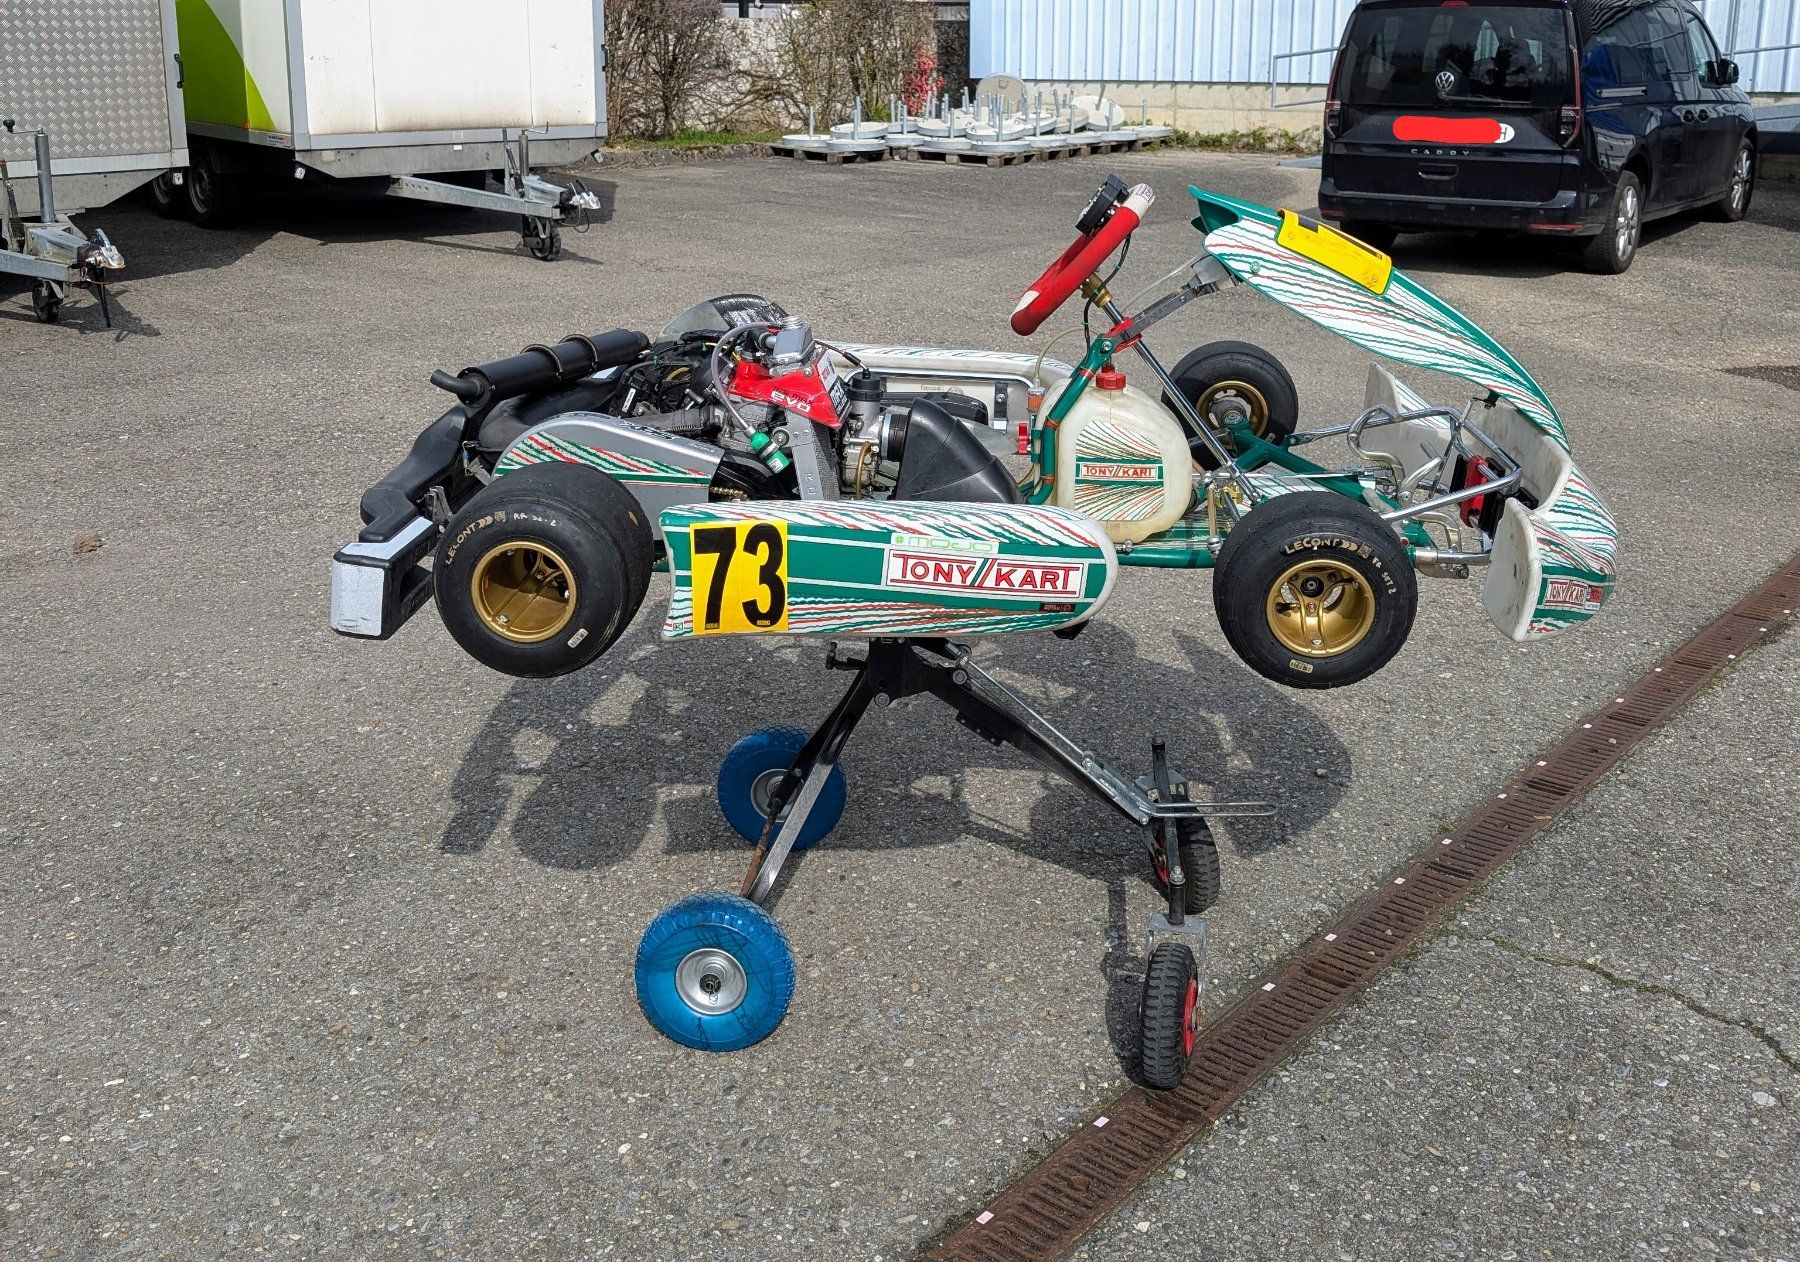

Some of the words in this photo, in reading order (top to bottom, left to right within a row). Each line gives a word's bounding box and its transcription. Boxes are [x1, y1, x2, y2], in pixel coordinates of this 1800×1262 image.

[1411, 148, 1470, 156] CADDY
[1083, 464, 1115, 476] TONY
[1121, 465, 1155, 477] KART
[693, 522, 786, 631] 73
[892, 553, 977, 585] TONY
[994, 562, 1081, 591] KART
